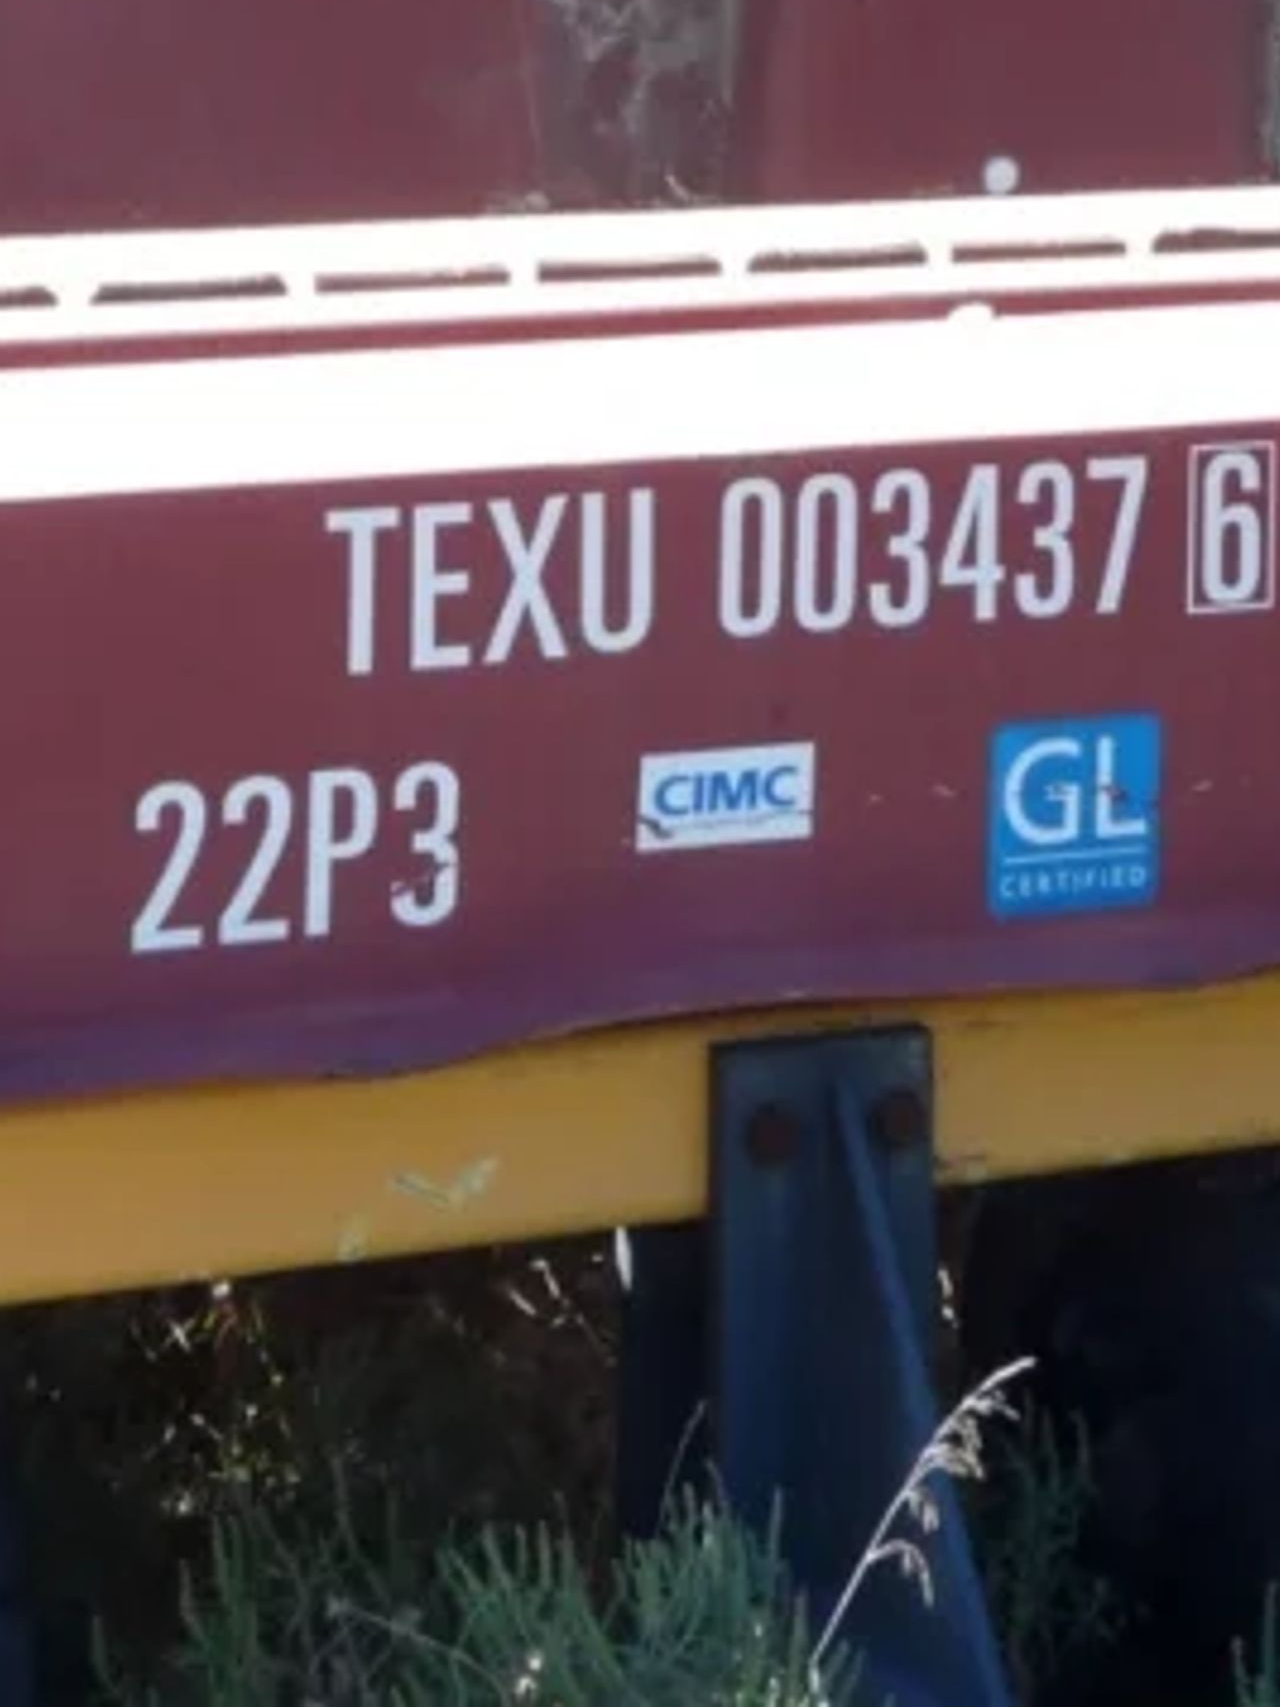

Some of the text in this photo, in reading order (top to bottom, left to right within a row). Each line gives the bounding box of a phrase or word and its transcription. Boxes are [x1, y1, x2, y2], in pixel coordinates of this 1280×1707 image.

[325, 449, 1264, 675] TEXU 003437 6
[652, 764, 799, 818] CIMC
[1002, 734, 1148, 846] GL
[130, 760, 461, 955] 22P3
[998, 865, 1147, 900] CERTIFIED
